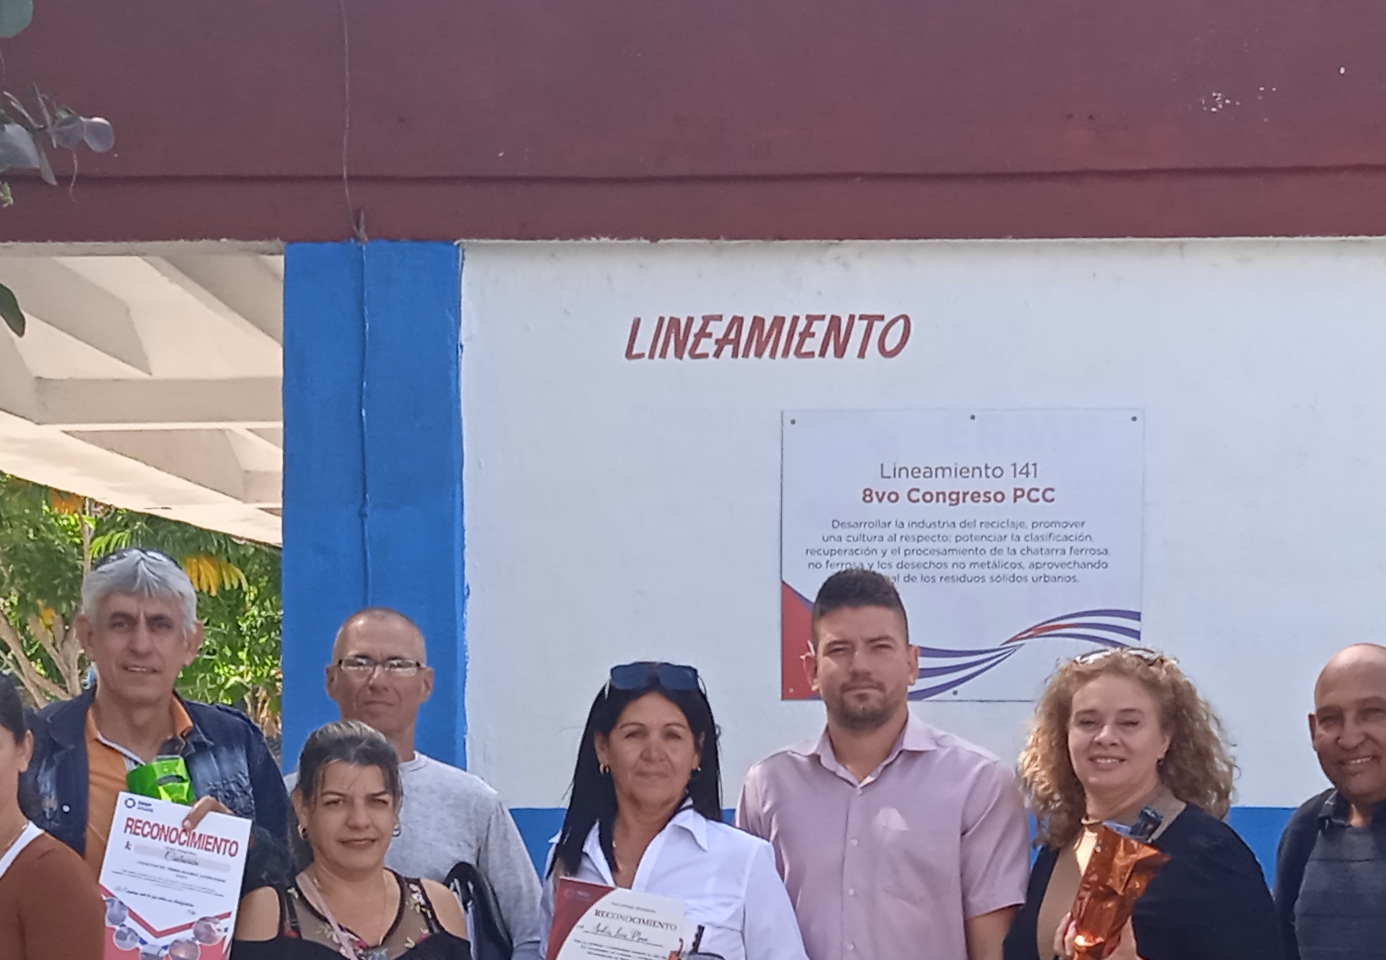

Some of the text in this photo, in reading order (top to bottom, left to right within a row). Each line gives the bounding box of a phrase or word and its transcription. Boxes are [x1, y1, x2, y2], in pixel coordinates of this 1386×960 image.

[625, 314, 911, 360] LINEAMIENTO
[880, 462, 1038, 479] Lineamiento 141
[862, 487, 1056, 507] 8vo Congreso PCC
[831, 519, 892, 529] Desarrollar
[895, 519, 905, 529] la
[907, 519, 956, 529] industria
[959, 519, 976, 529] del
[1031, 520, 1086, 531] promover
[822, 535, 843, 543] una
[845, 533, 884, 543] cultura
[887, 533, 897, 543] al
[954, 533, 1008, 545] potenciar
[1011, 533, 1021, 543] la
[805, 546, 878, 558] recuperación
[881, 549, 887, 558] y
[891, 547, 901, 556] el
[903, 546, 986, 558] procesamiento
[989, 546, 1004, 556] de
[1007, 546, 1017, 556] la
[1019, 545, 1066, 556] chatarra
[808, 561, 822, 570] no
[877, 560, 893, 570] los
[896, 560, 948, 570] desechos
[951, 561, 966, 570] no
[1028, 559, 1109, 571] aprovechando
[903, 573, 917, 583] de
[920, 573, 936, 583] los
[939, 573, 986, 583] residuos
[989, 573, 1028, 583] sólidos
[124, 817, 239, 858] RECONOCIMIENTO
[594, 909, 677, 931] RECONOCIMIENTO
